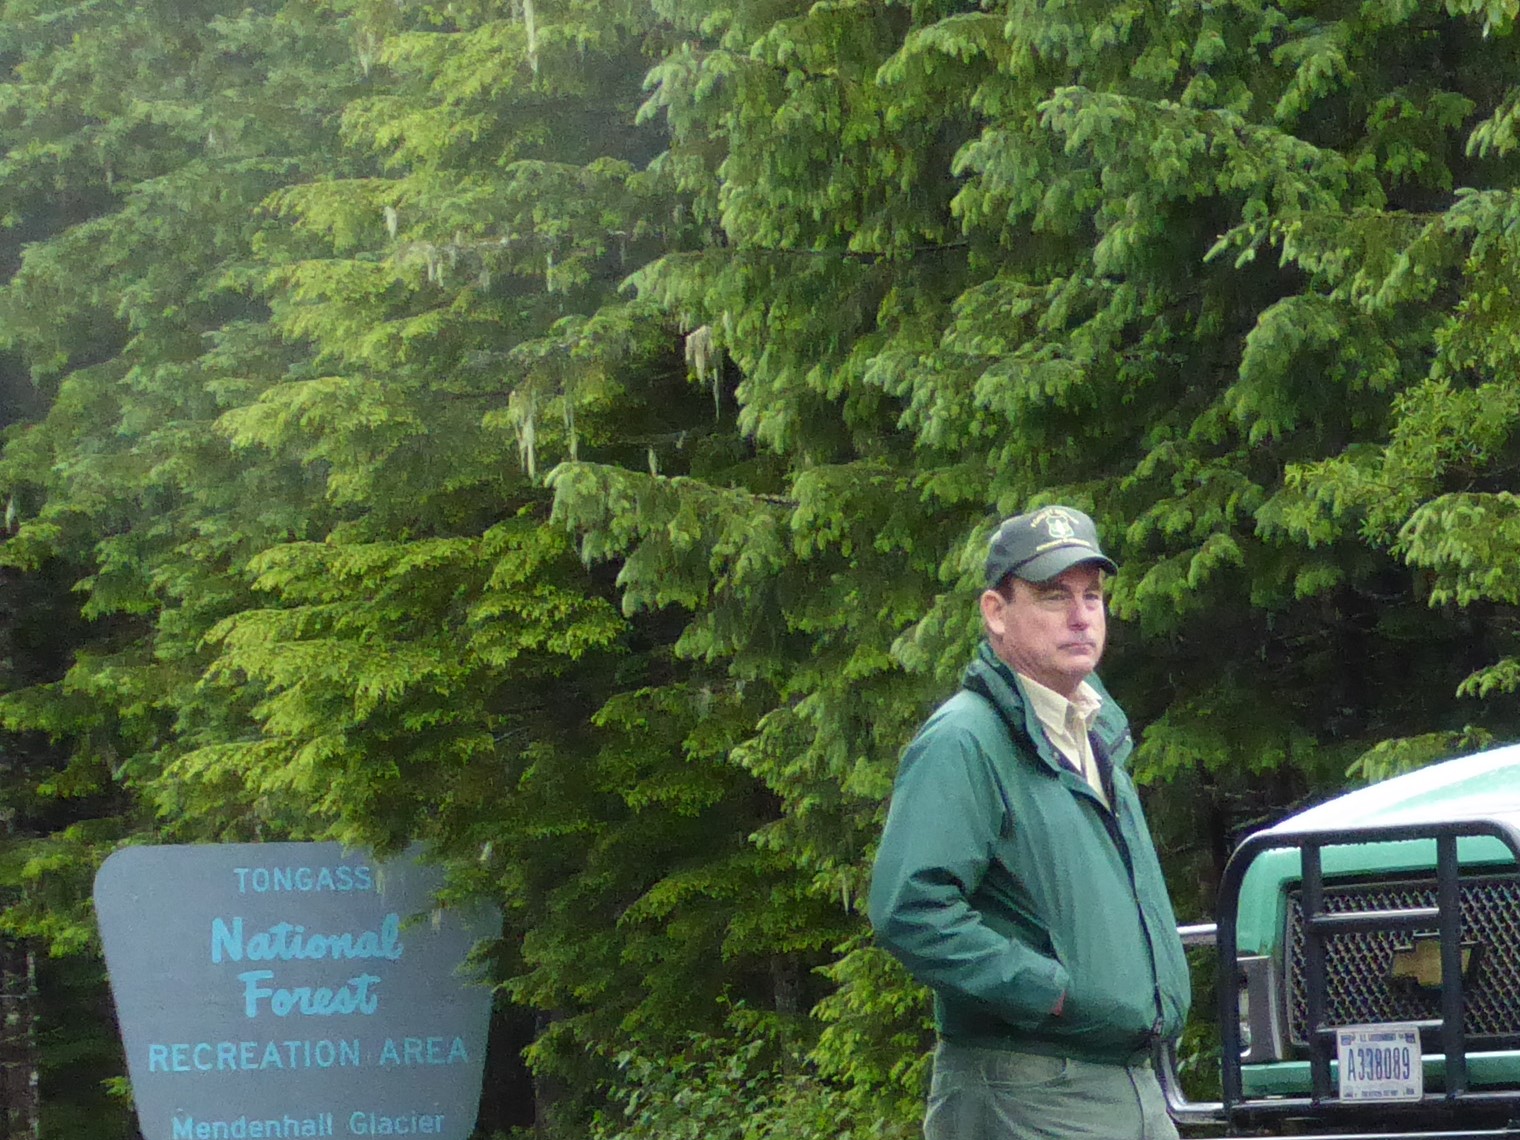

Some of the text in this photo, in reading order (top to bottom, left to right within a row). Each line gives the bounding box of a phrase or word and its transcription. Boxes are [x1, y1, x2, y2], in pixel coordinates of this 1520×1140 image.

[233, 866, 373, 893] TONGASS
[211, 913, 404, 964] National
[237, 969, 382, 1018] Forest
[149, 1036, 469, 1072] RECREATION AREA
[1347, 1046, 1411, 1081] A338089
[171, 1110, 446, 1140] Mendenhall Glacier
